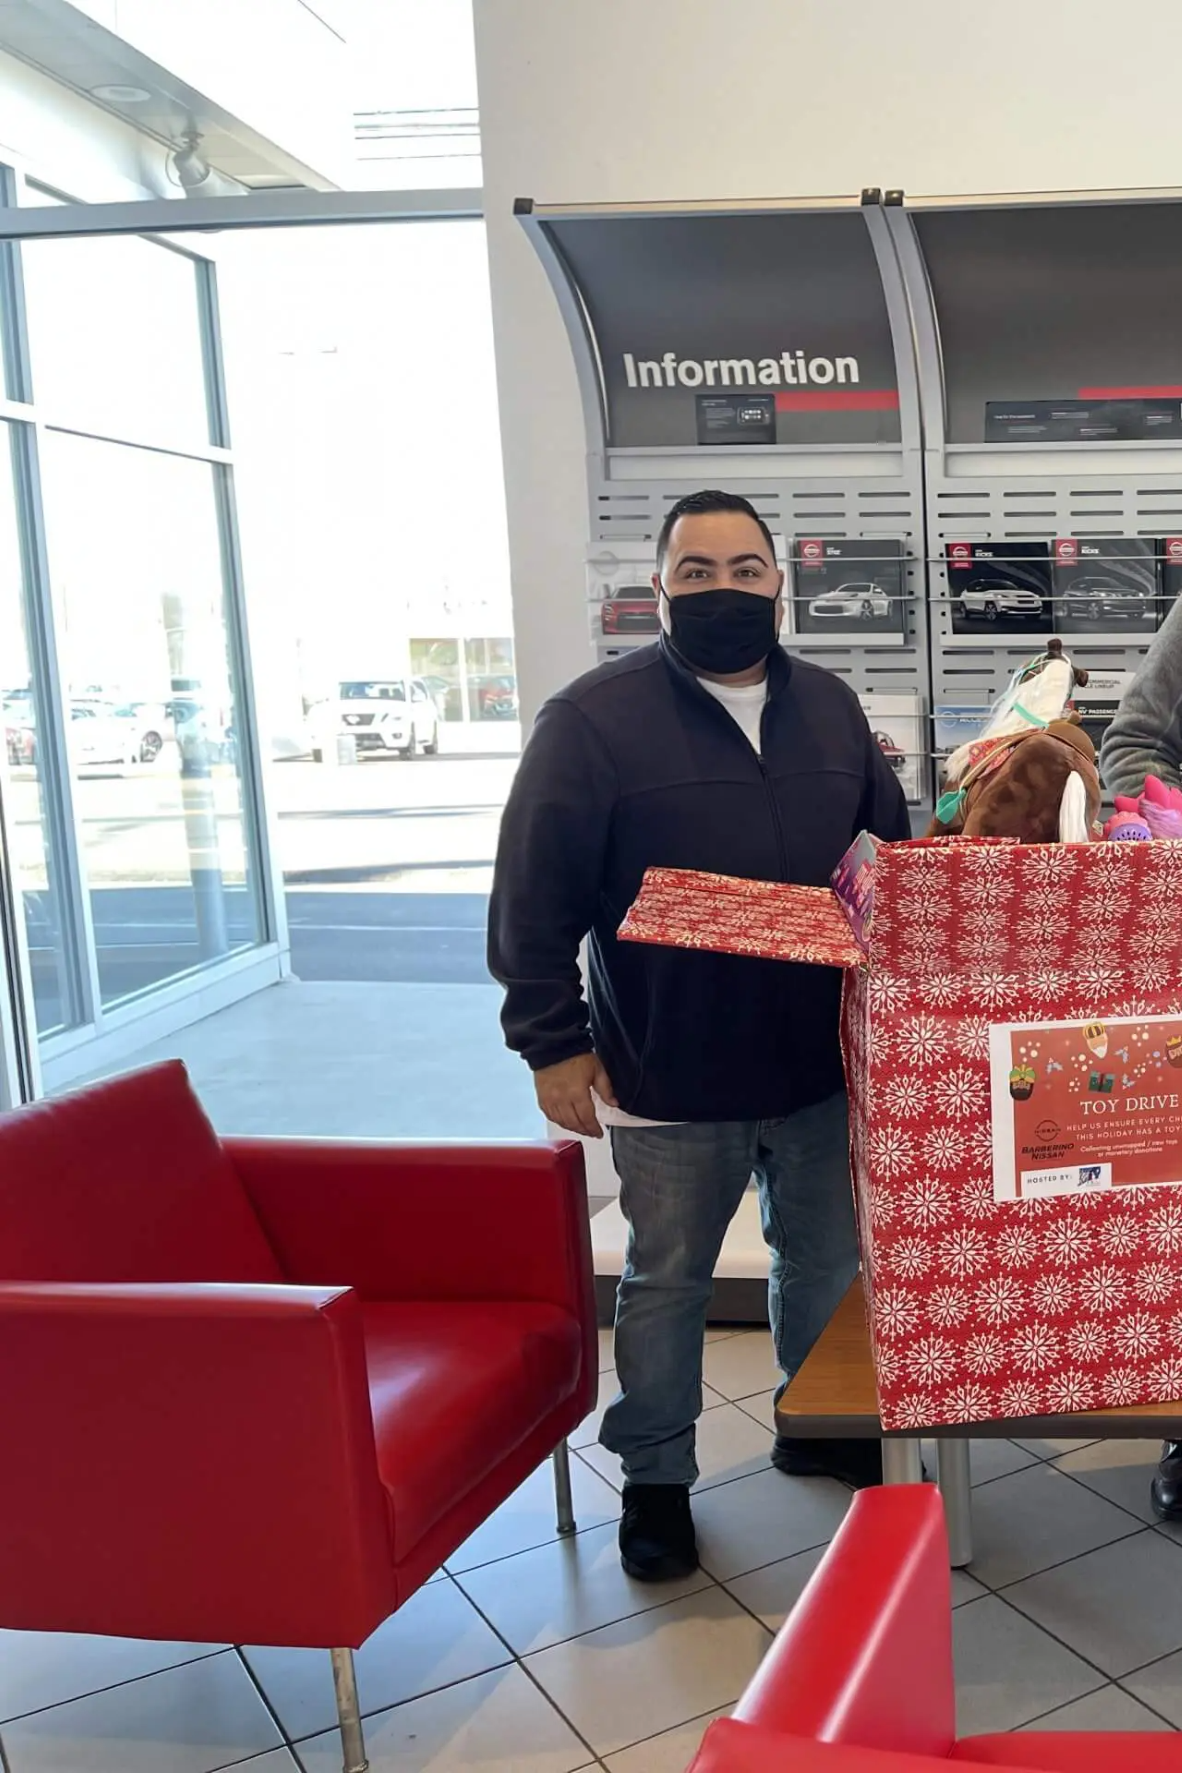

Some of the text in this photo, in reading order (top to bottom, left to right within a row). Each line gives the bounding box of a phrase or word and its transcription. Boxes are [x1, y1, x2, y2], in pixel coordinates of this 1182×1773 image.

[623, 350, 860, 388] Information
[1080, 1094, 1179, 1115] TOY DRIVE
[1066, 1124, 1087, 1132] HELP
[1104, 1119, 1136, 1128] ENSURE
[1139, 1117, 1165, 1125] EVERY
[1097, 1130, 1133, 1139] HOLIDAY
[1021, 1143, 1075, 1154] BARBERINO
[1031, 1151, 1065, 1160] NISSAN
[1027, 1176, 1057, 1184] HOSTED
